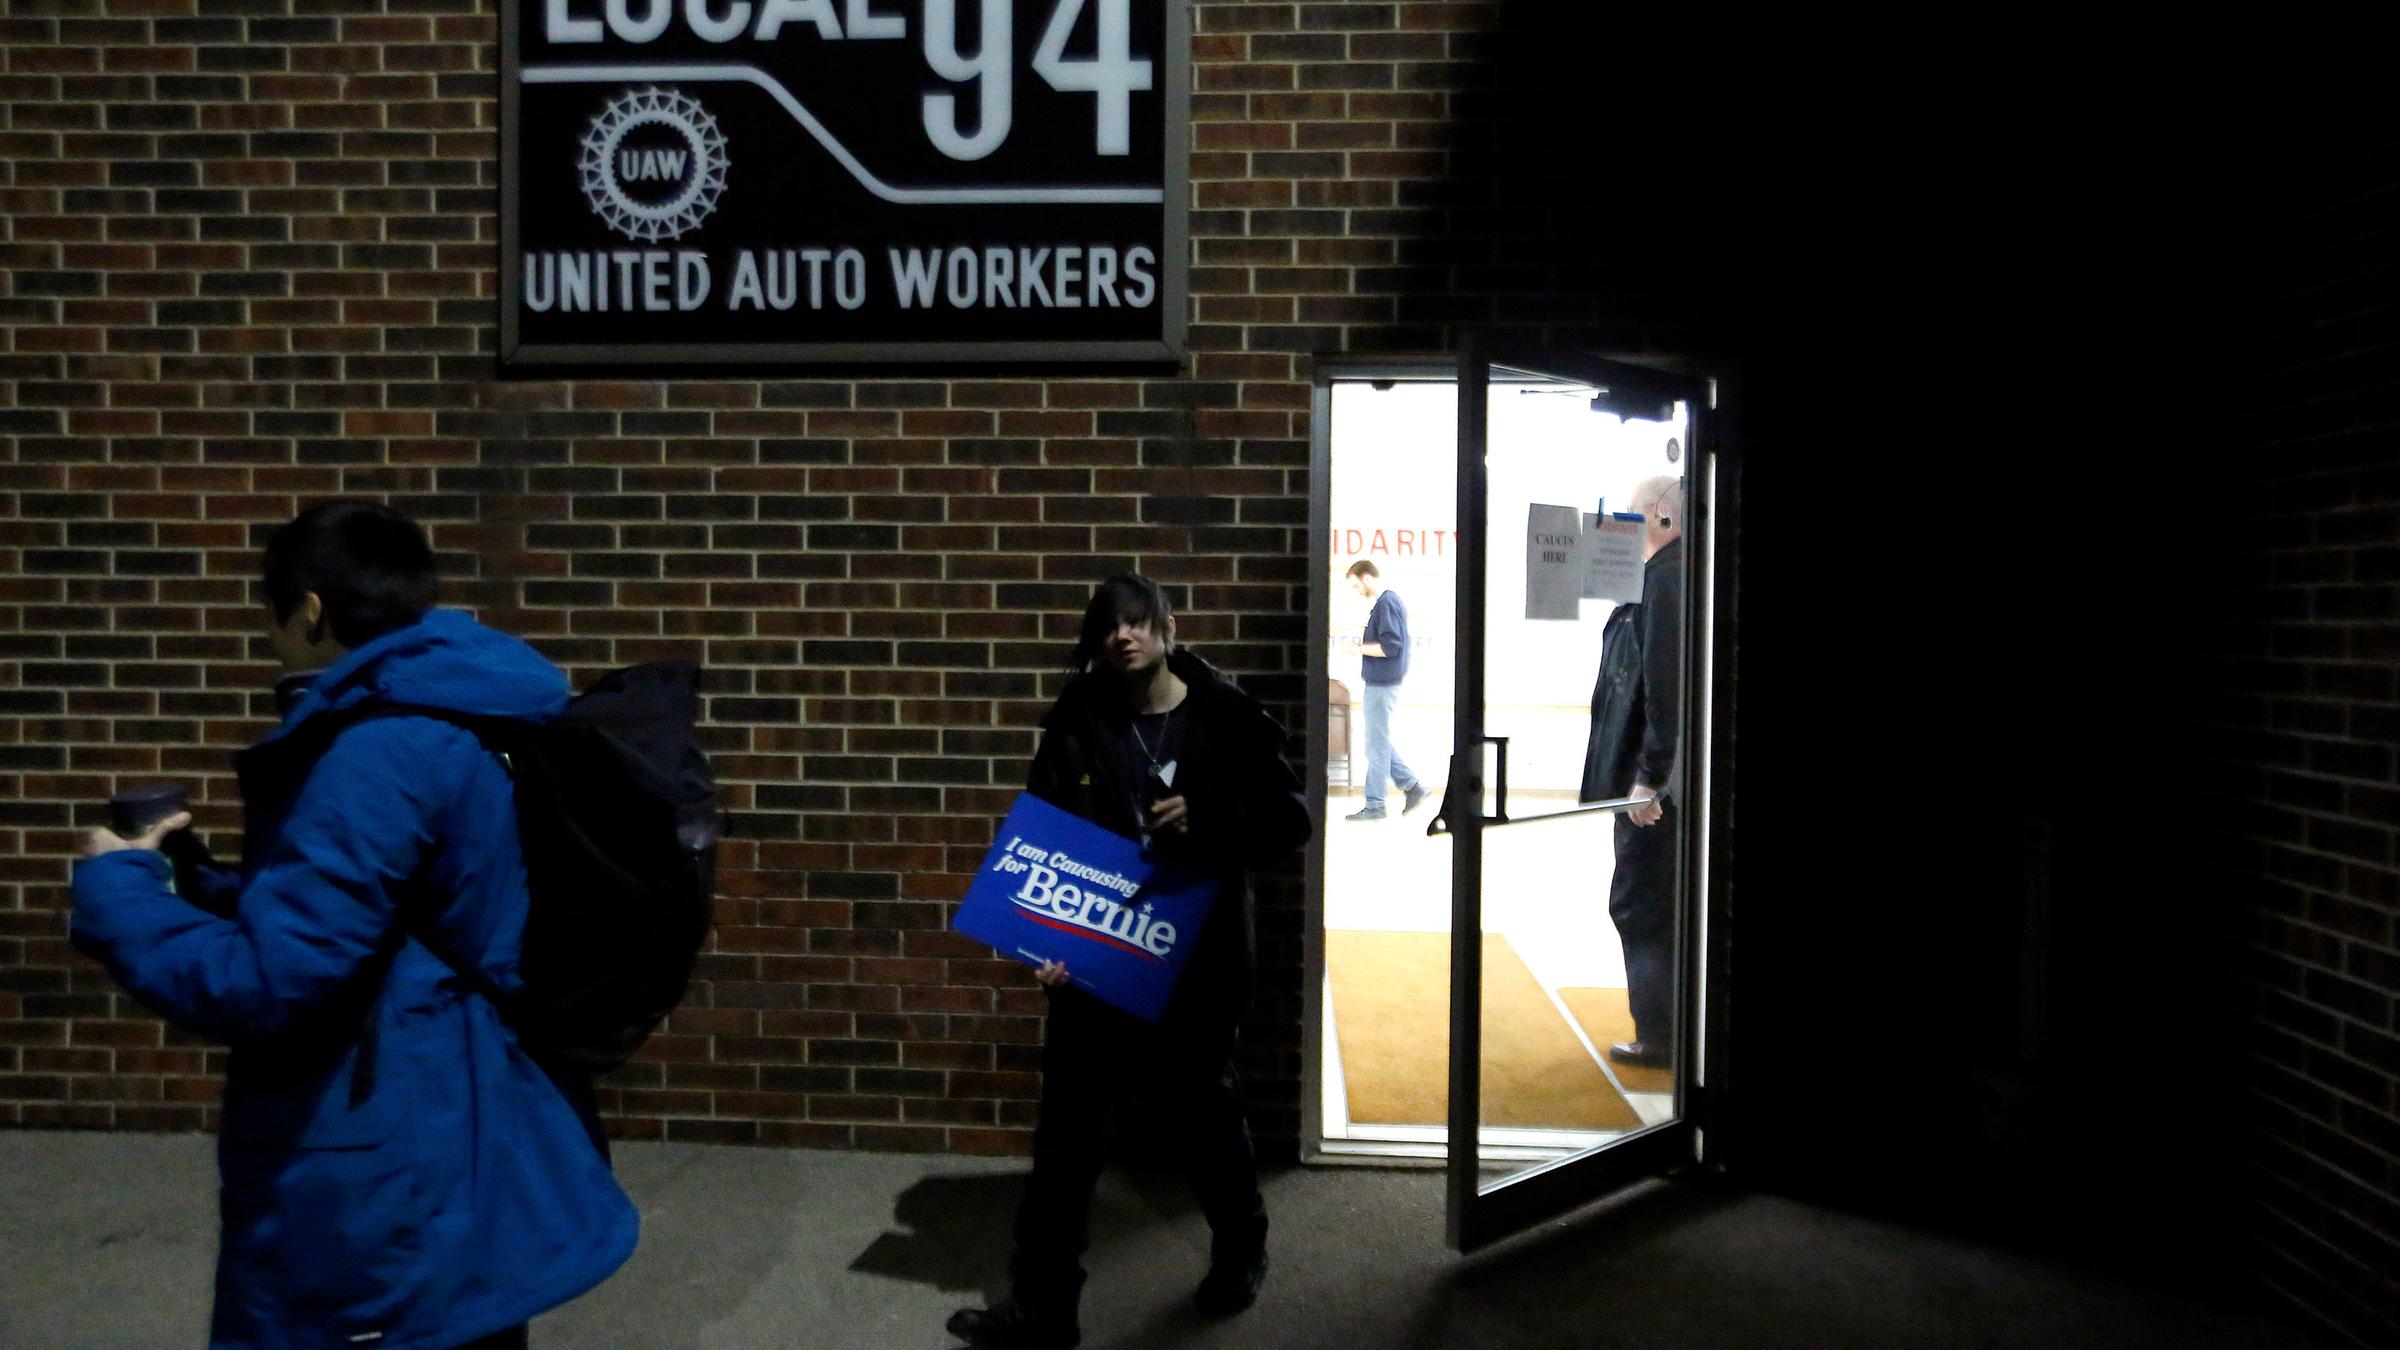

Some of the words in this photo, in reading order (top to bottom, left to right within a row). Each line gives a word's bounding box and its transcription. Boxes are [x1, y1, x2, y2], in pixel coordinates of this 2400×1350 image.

[922, 0, 1153, 161] 94
[621, 150, 688, 182] UAW
[525, 250, 711, 312] UNITED
[729, 248, 866, 310] AUTO
[889, 246, 1156, 309] WORKERS
[1543, 551, 1567, 563] HERE
[992, 854, 1029, 875] for
[1005, 836, 1022, 852] I
[1016, 844, 1049, 864] am
[1049, 852, 1142, 899] Caucusing
[1017, 862, 1177, 956] Bernie
